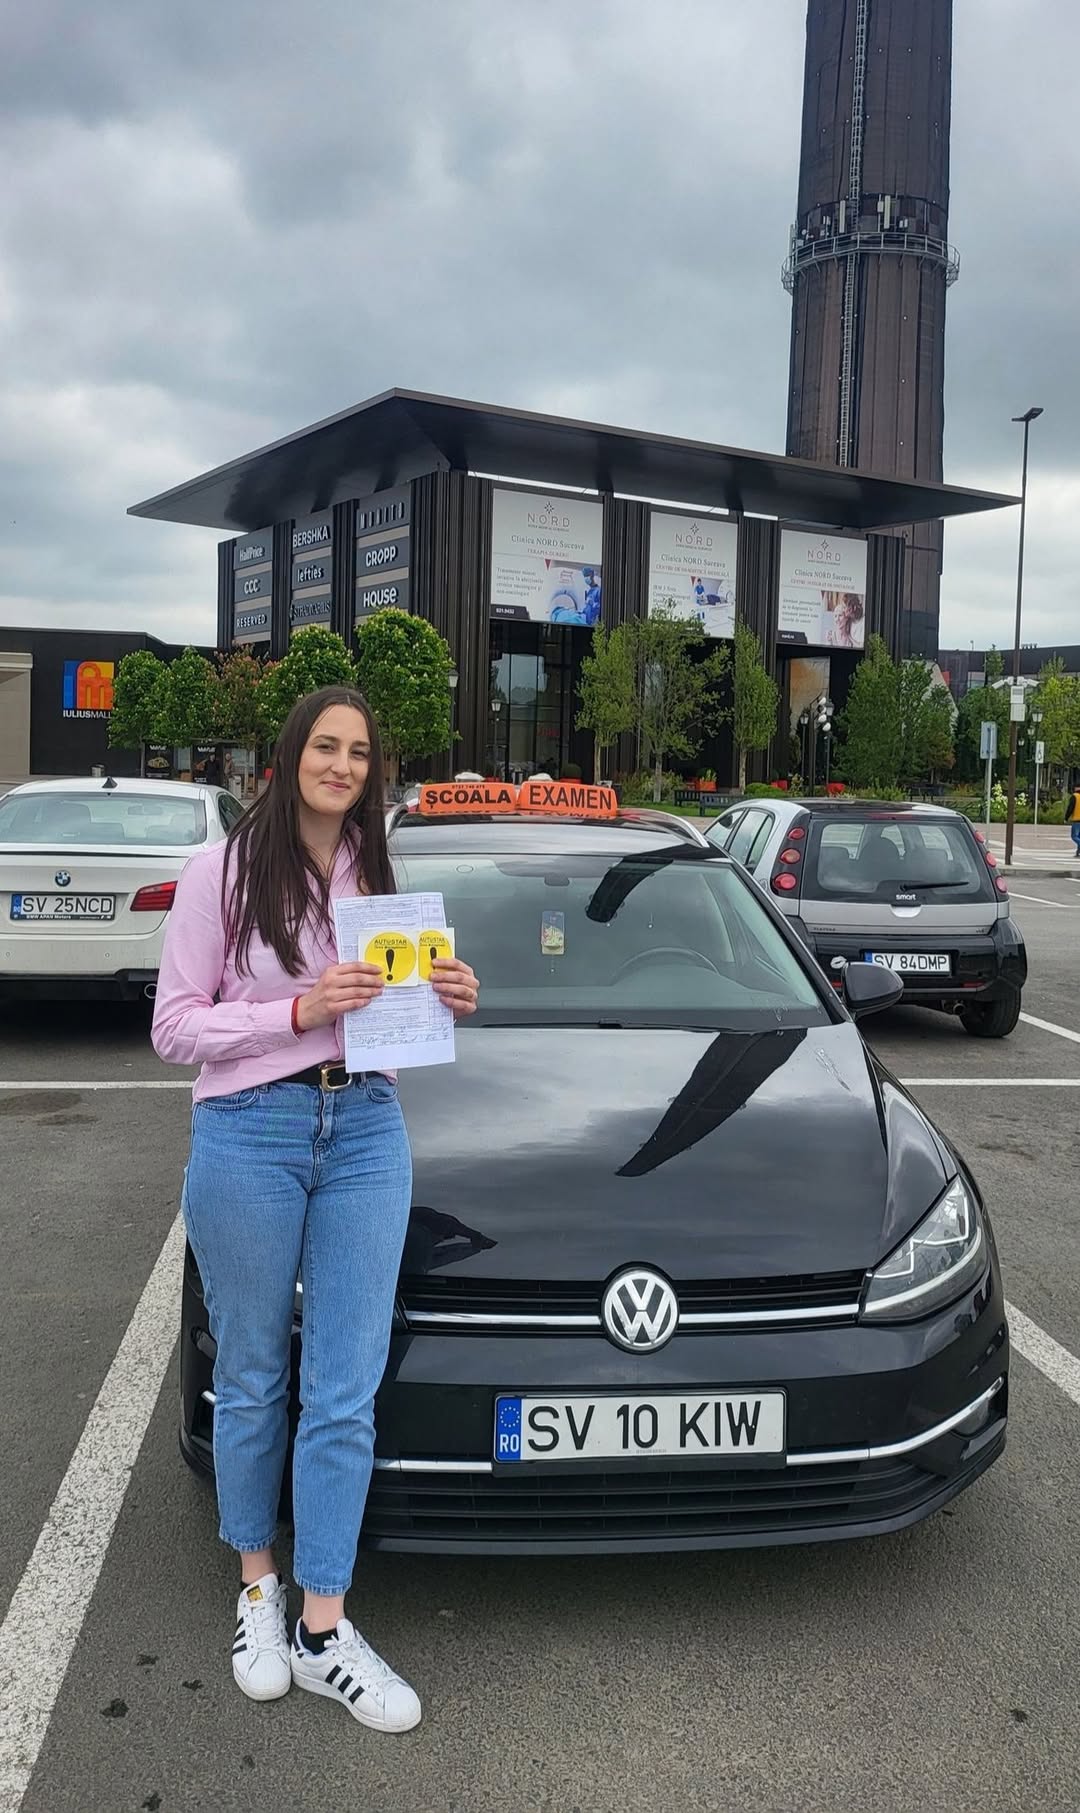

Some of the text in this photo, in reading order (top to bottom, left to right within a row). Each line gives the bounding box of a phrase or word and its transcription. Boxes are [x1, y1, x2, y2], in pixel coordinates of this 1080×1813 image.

[528, 513, 570, 528] NORD
[292, 525, 329, 548] BERSHKA
[536, 537, 558, 547] NORD
[676, 533, 713, 547] NORD
[365, 545, 397, 568] CROPP
[683, 556, 702, 565] NORD
[807, 550, 841, 562] NORD
[297, 565, 322, 582] lefties
[814, 571, 832, 579] NORD
[244, 581, 260, 594] CCC
[236, 613, 266, 629] RESERVED
[63, 709, 113, 719] IULIUSMALL
[425, 785, 612, 810] ȘCOALA EXAMEN
[22, 897, 113, 913] SV 25NCD
[874, 955, 948, 970] SV 84DMP
[527, 1400, 762, 1451] SV 10 KIW
[500, 1433, 520, 1453] RO
